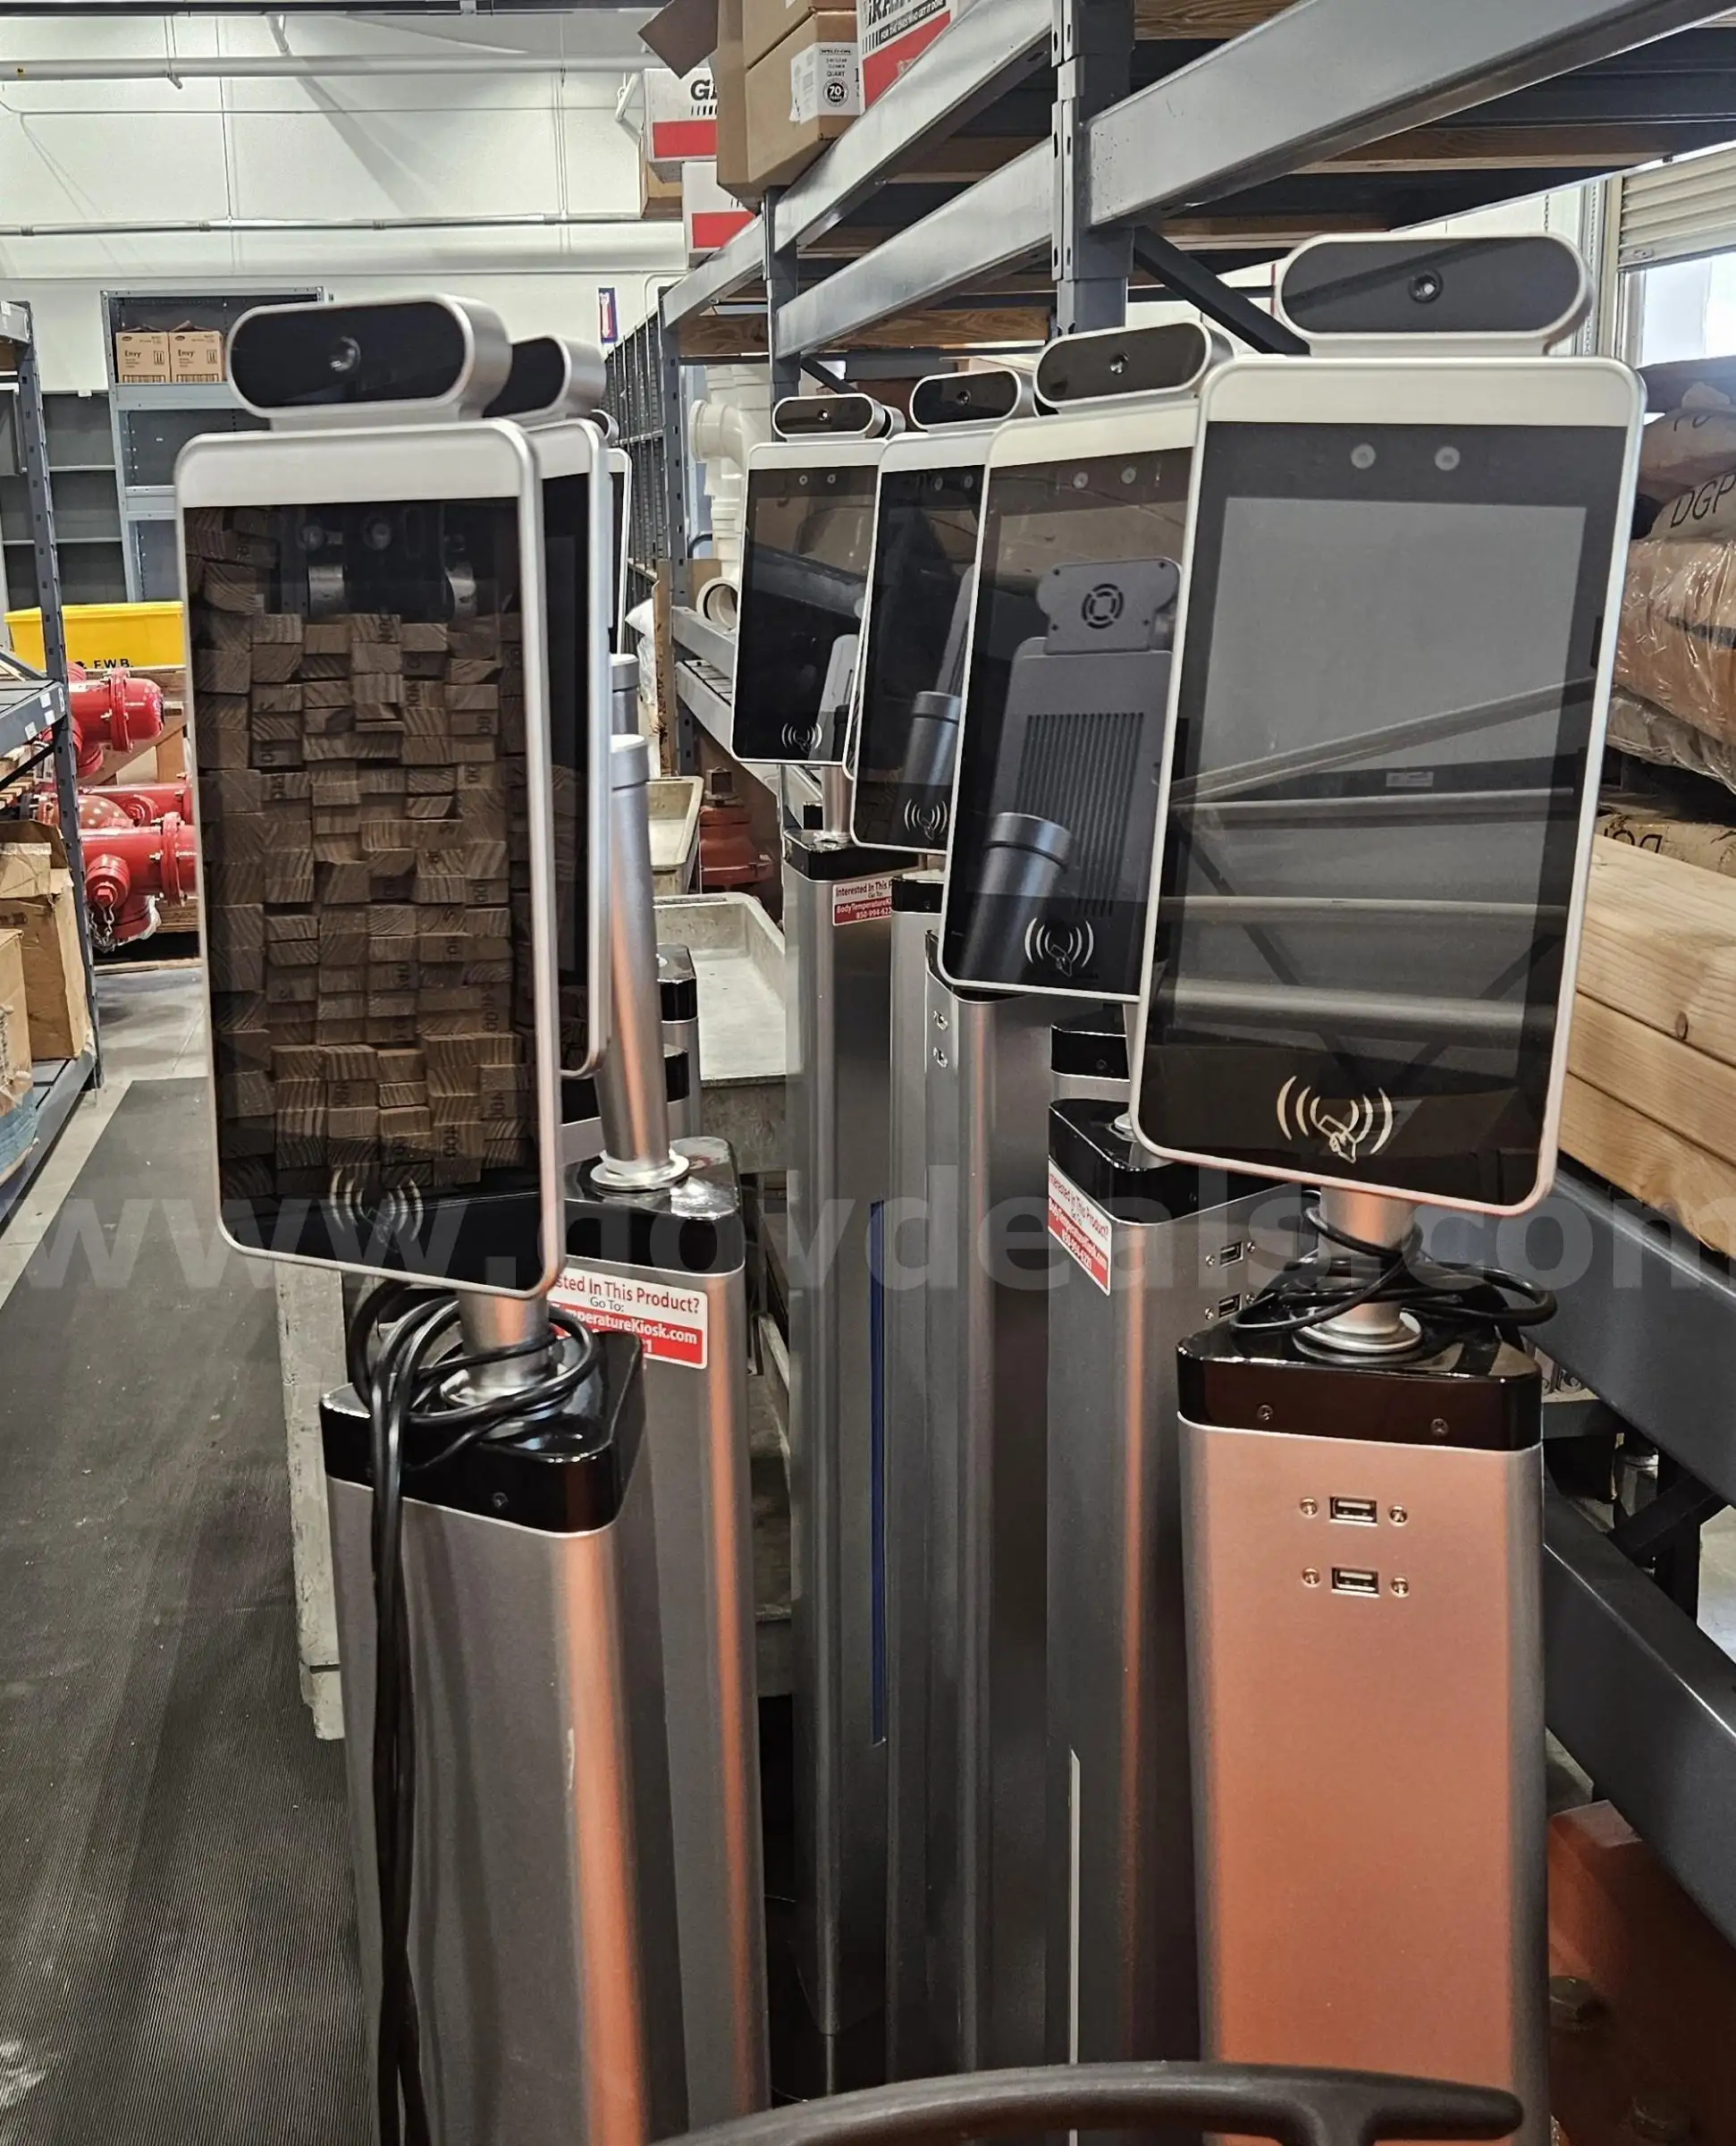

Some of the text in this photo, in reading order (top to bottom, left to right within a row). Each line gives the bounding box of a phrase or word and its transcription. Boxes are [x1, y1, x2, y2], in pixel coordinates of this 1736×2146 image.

[124, 350, 142, 358] Envy
[178, 349, 195, 358] Envy
[1670, 471, 1736, 528] DGP
[836, 883, 867, 897] Interested
[836, 899, 891, 914] BodyTemperatureK
[855, 908, 891, 919] 850-994-622
[590, 1278, 602, 1296] In
[604, 1280, 634, 1302] This
[636, 1287, 700, 1314] Product?
[590, 1297, 625, 1313] Go To:
[565, 1308, 697, 1345] peratureKiosk.com
